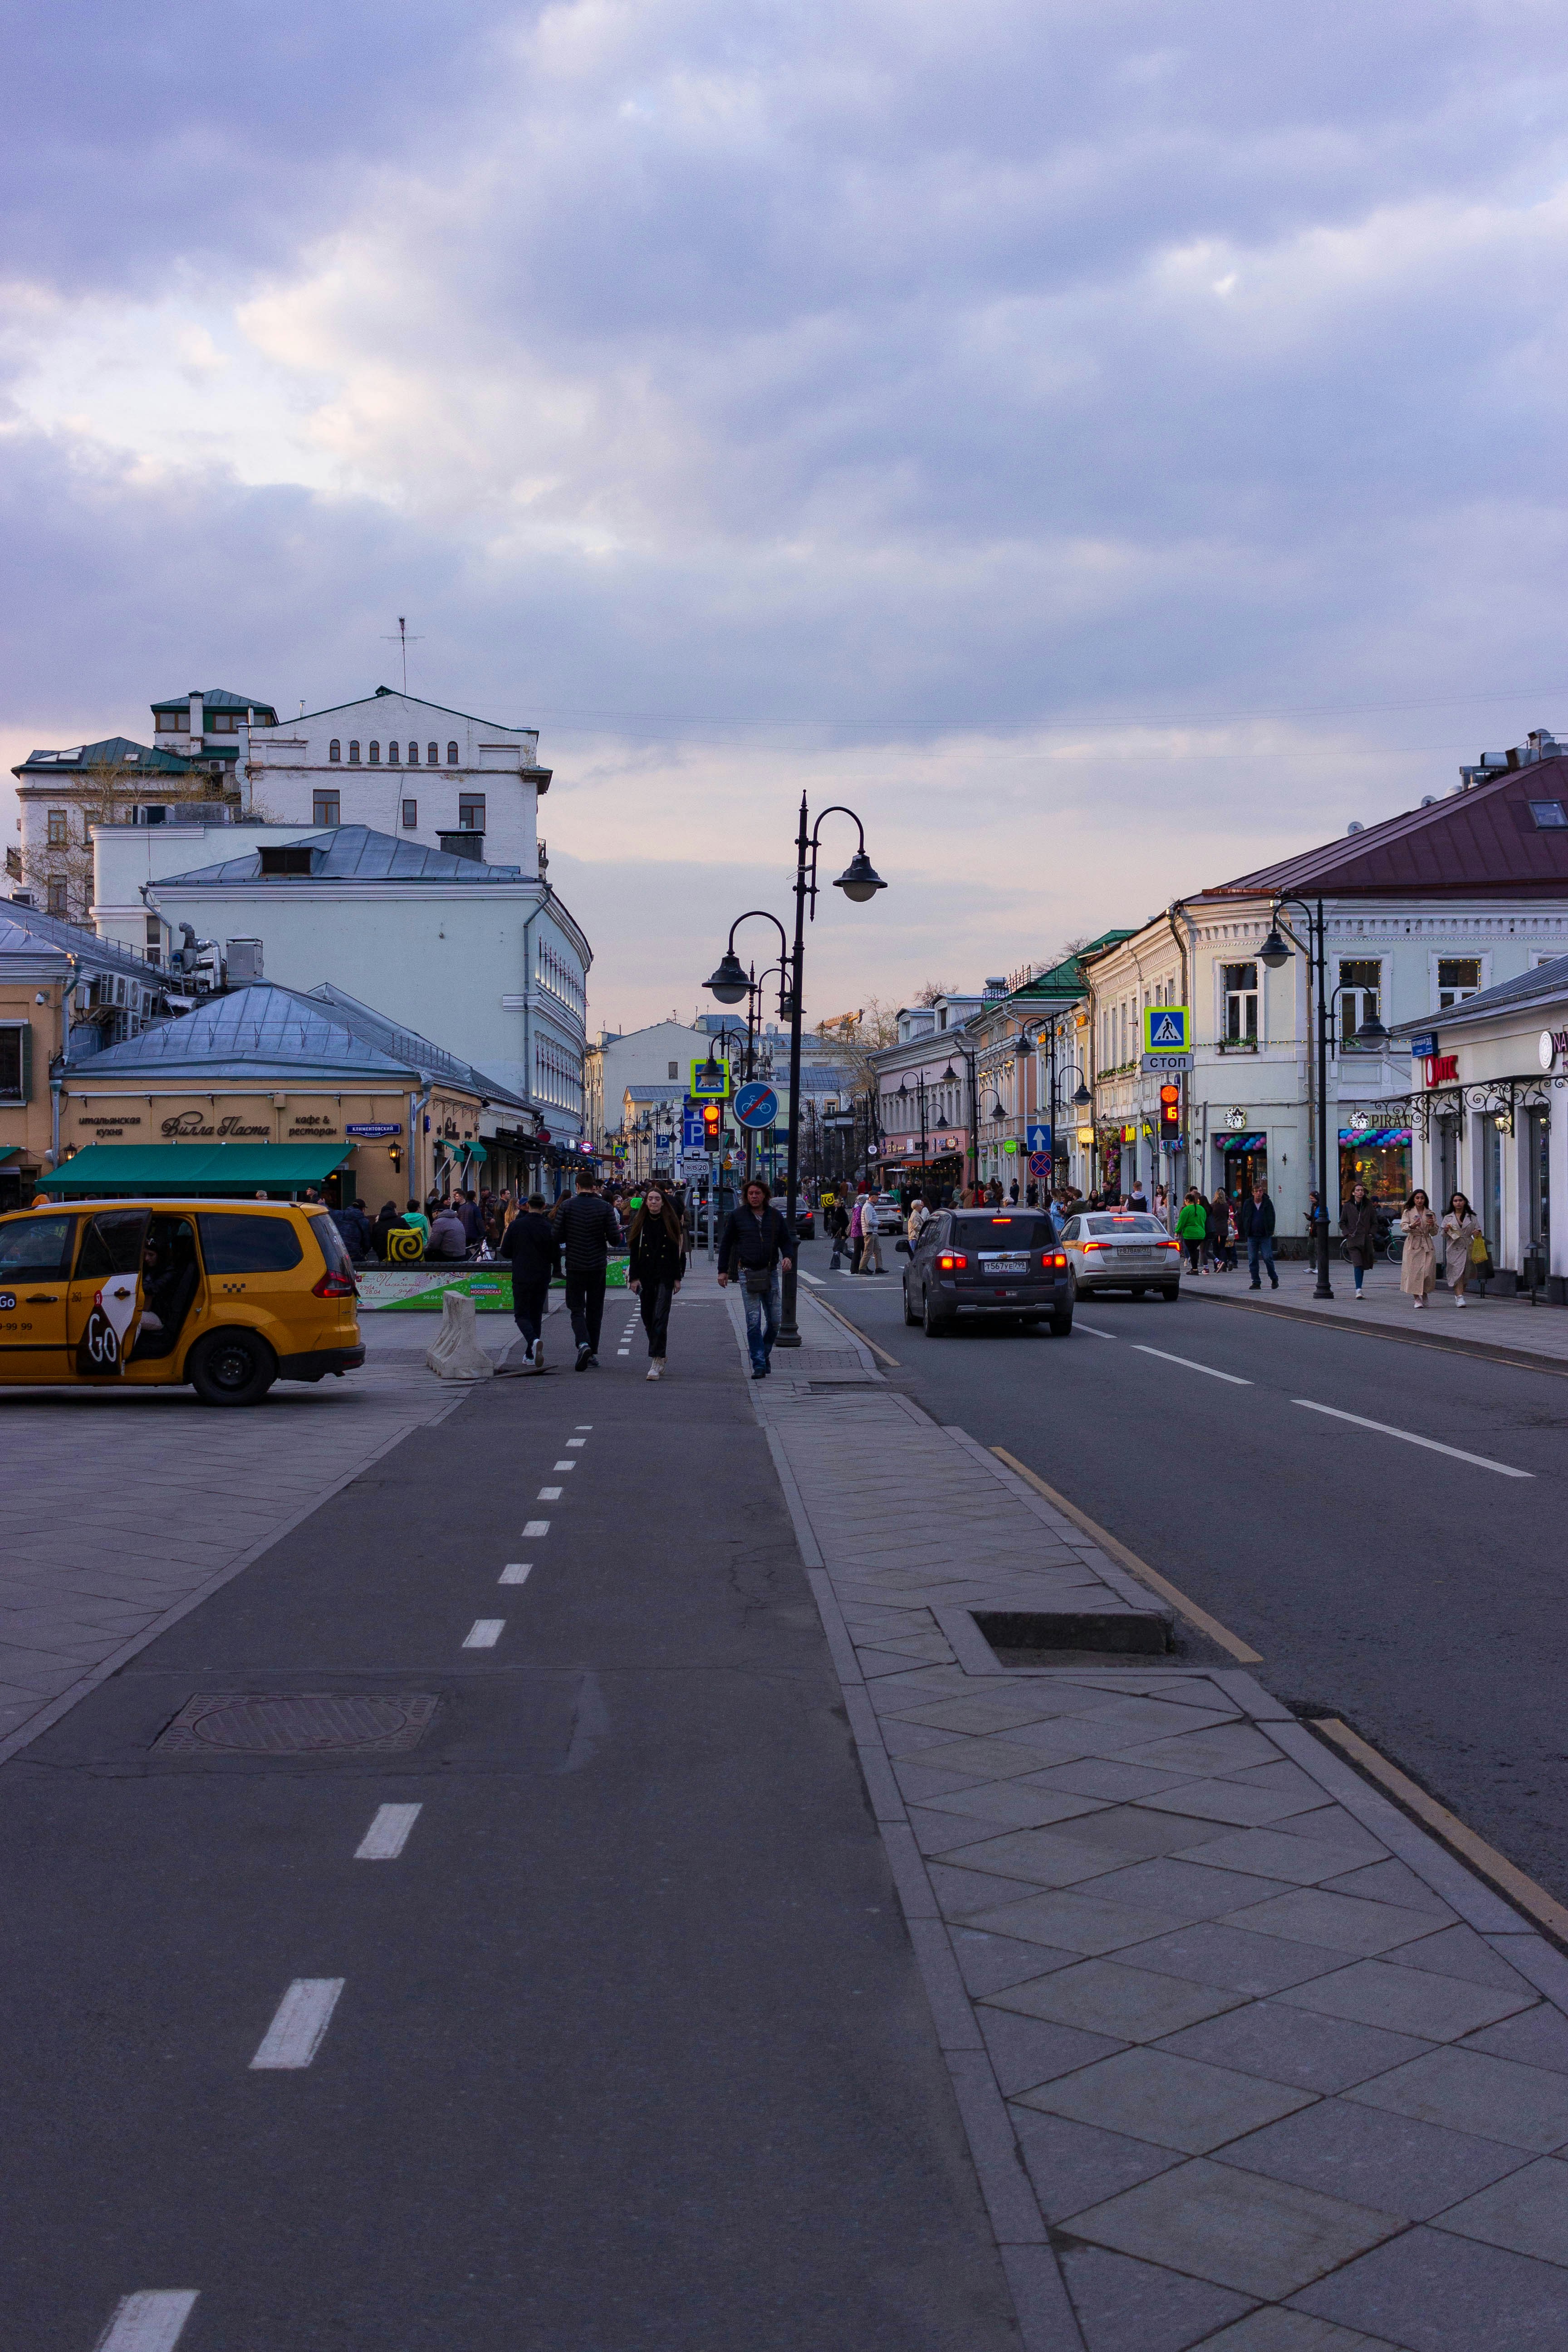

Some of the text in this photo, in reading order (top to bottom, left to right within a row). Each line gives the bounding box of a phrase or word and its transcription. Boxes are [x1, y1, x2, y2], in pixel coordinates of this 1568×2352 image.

[1150, 1058, 1186, 1068] СТОП
[1167, 1107, 1177, 1119] 16
[162, 1111, 270, 1137] Вилла Паста
[295, 1115, 330, 1125] кафе &
[96, 1128, 123, 1138] кухня
[289, 1127, 337, 1137] ресторан
[709, 1124, 717, 1134] 16
[0, 1296, 15, 1308] Go
[96, 1294, 100, 1304] Я
